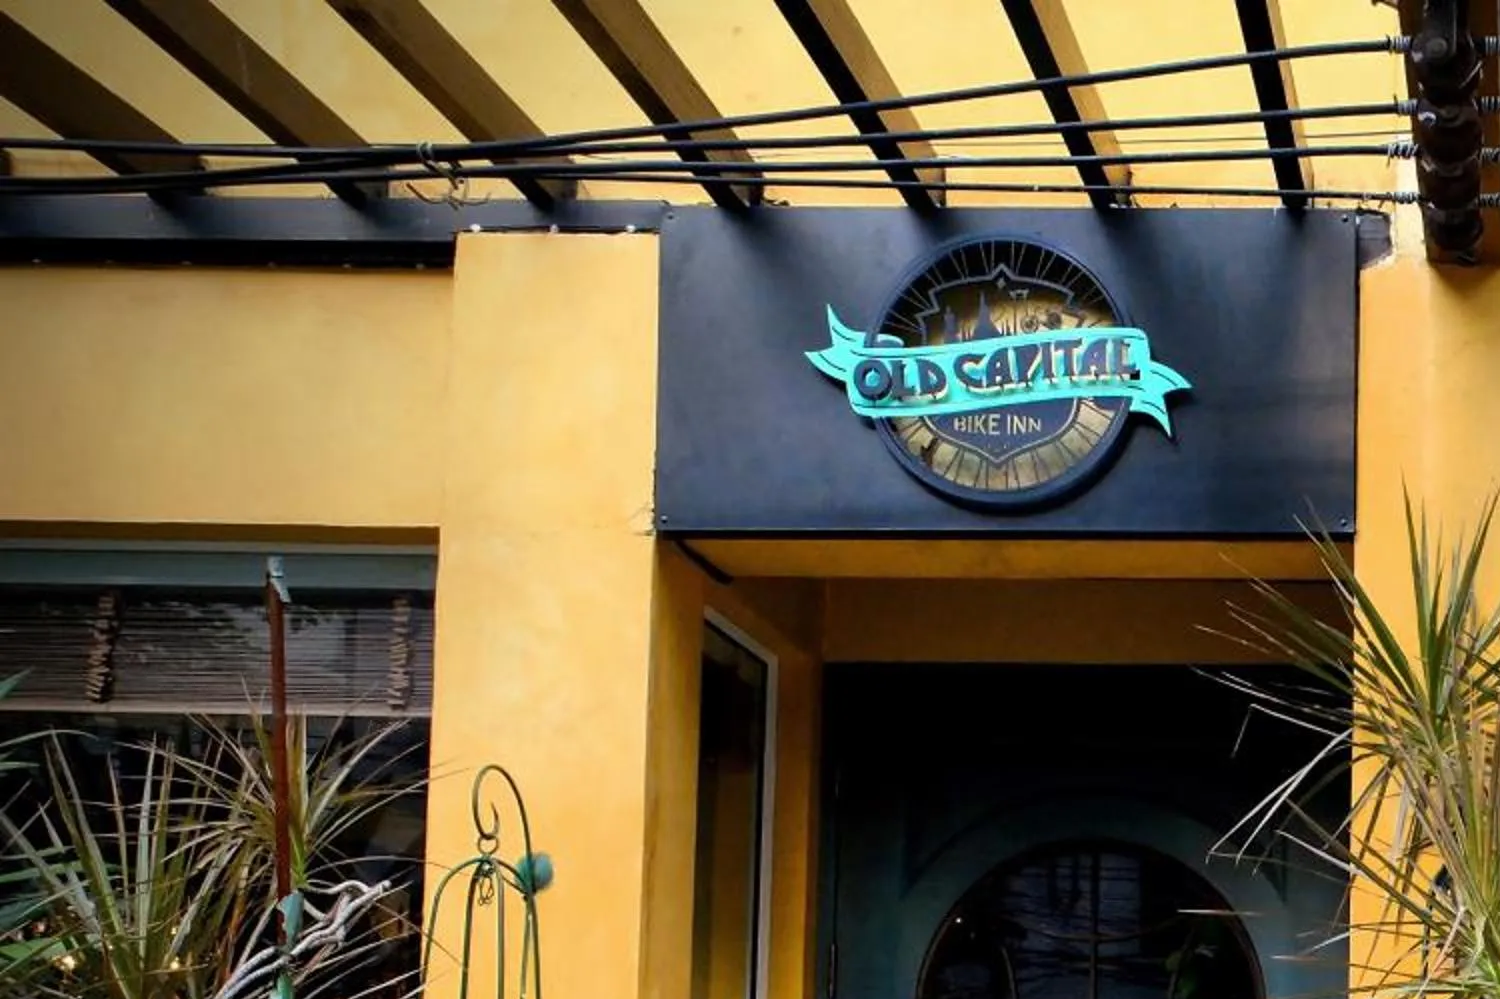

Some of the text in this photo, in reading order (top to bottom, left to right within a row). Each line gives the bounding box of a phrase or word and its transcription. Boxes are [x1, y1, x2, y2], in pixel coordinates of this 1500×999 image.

[853, 337, 1140, 400] OLD CAPITAL
[953, 413, 1042, 436] BIKE INN
